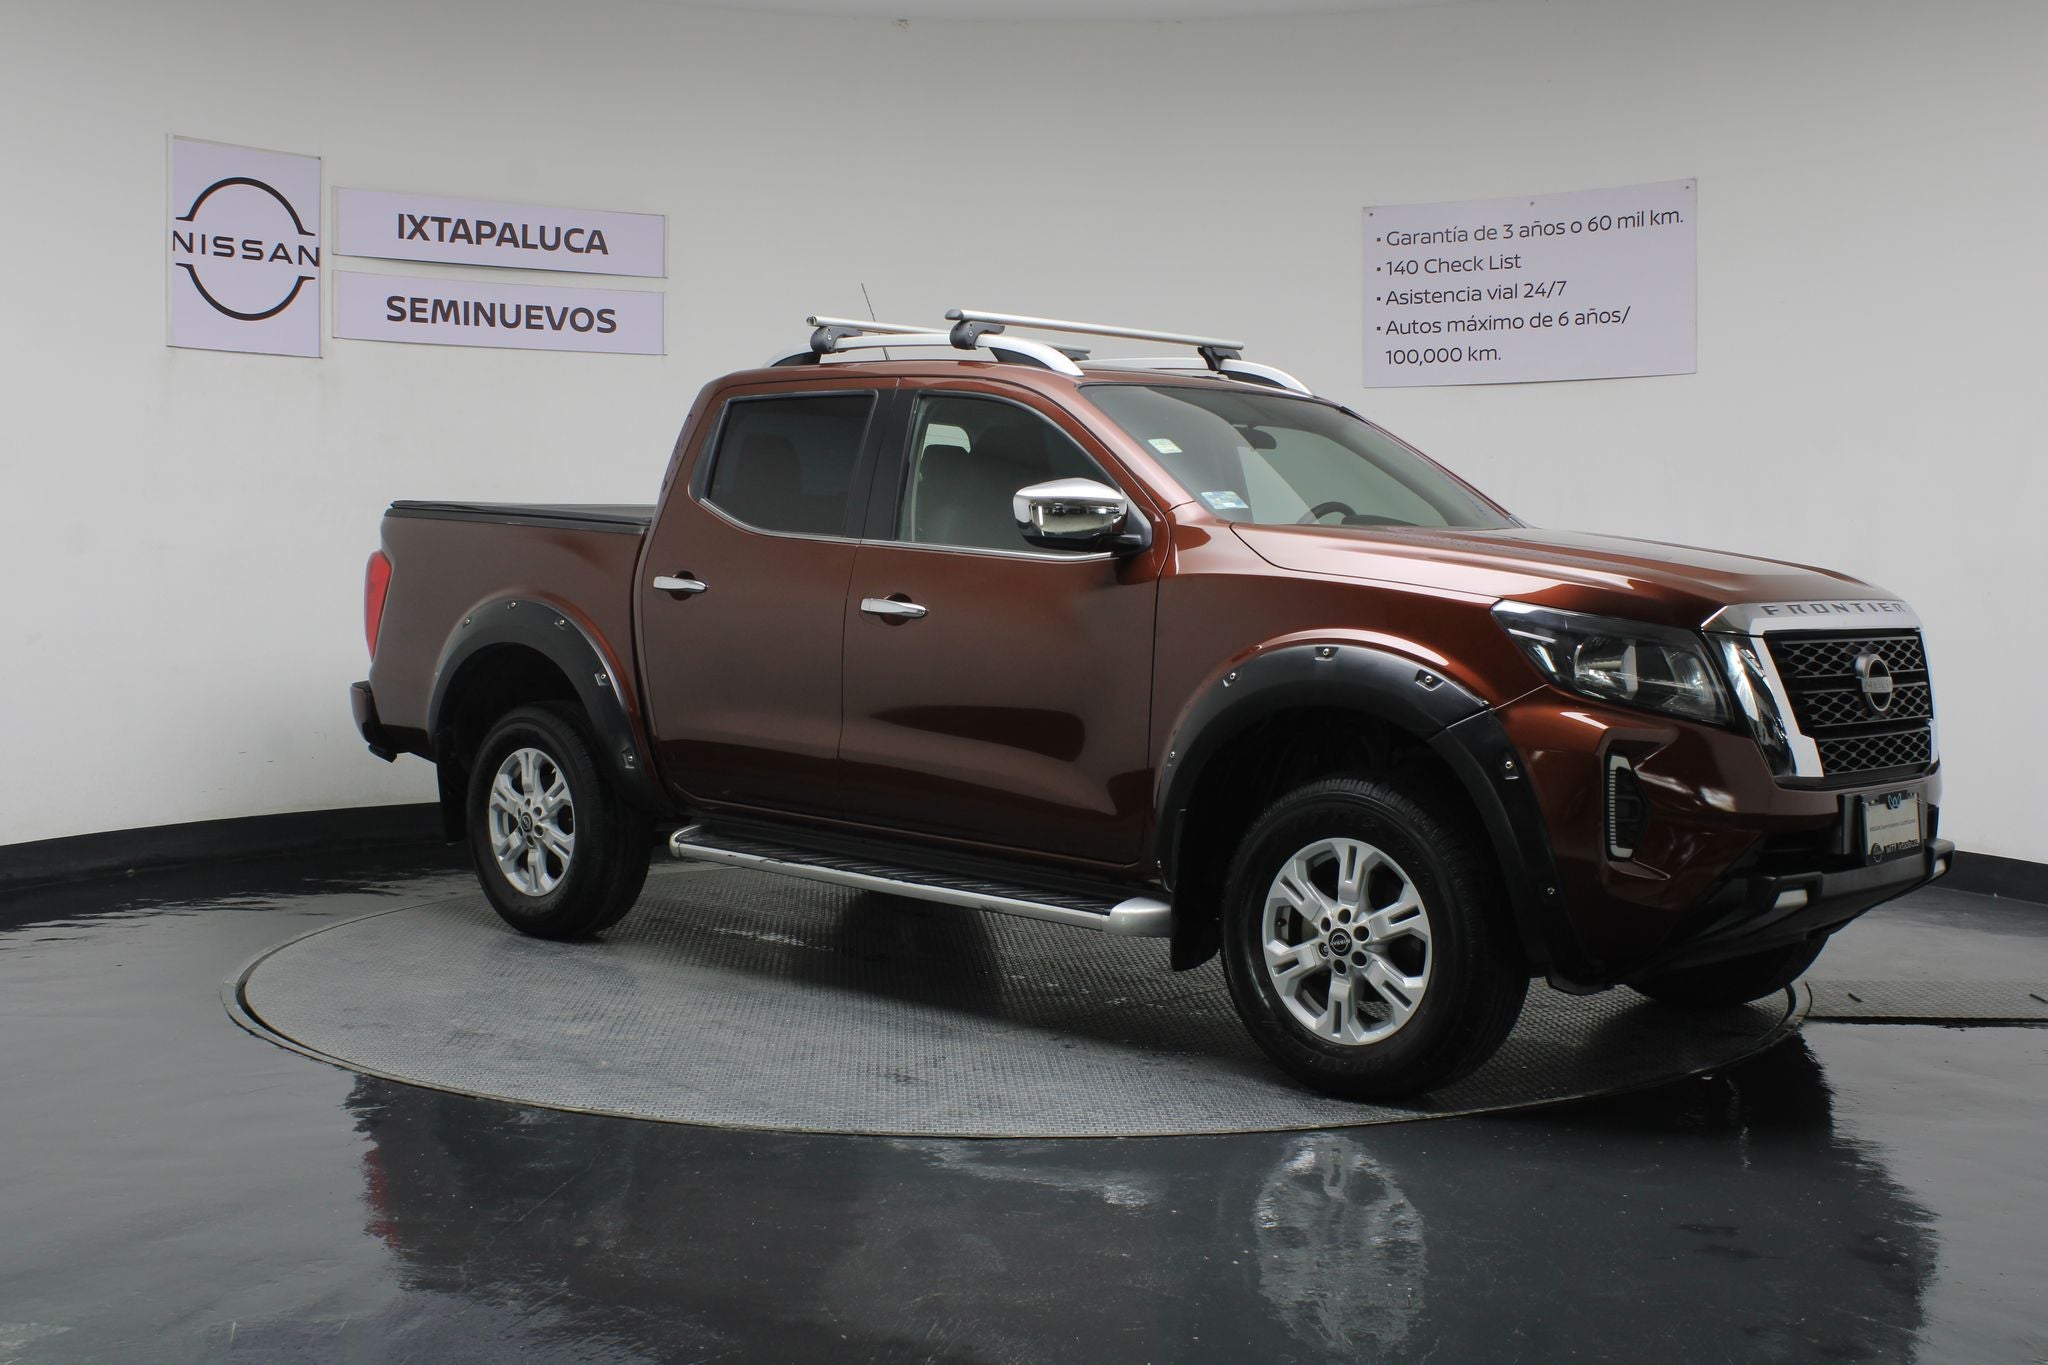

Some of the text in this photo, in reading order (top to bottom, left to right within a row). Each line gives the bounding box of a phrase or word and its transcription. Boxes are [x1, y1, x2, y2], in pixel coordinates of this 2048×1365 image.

[397, 213, 609, 255] IXTAPALUCA
[1387, 210, 1683, 246] Garantía de 3 años o 60 mil km.
[173, 230, 320, 267] NISSAN
[1386, 254, 1521, 276] 140 Check List
[1386, 281, 1567, 305] Asistencia vial 24/7
[386, 295, 617, 334] SEMINUEVOS
[1386, 306, 1631, 335] Autos máximo de 6 años/
[1386, 346, 1501, 366] 100,000 km.
[1761, 603, 1906, 616] FRONTIER
